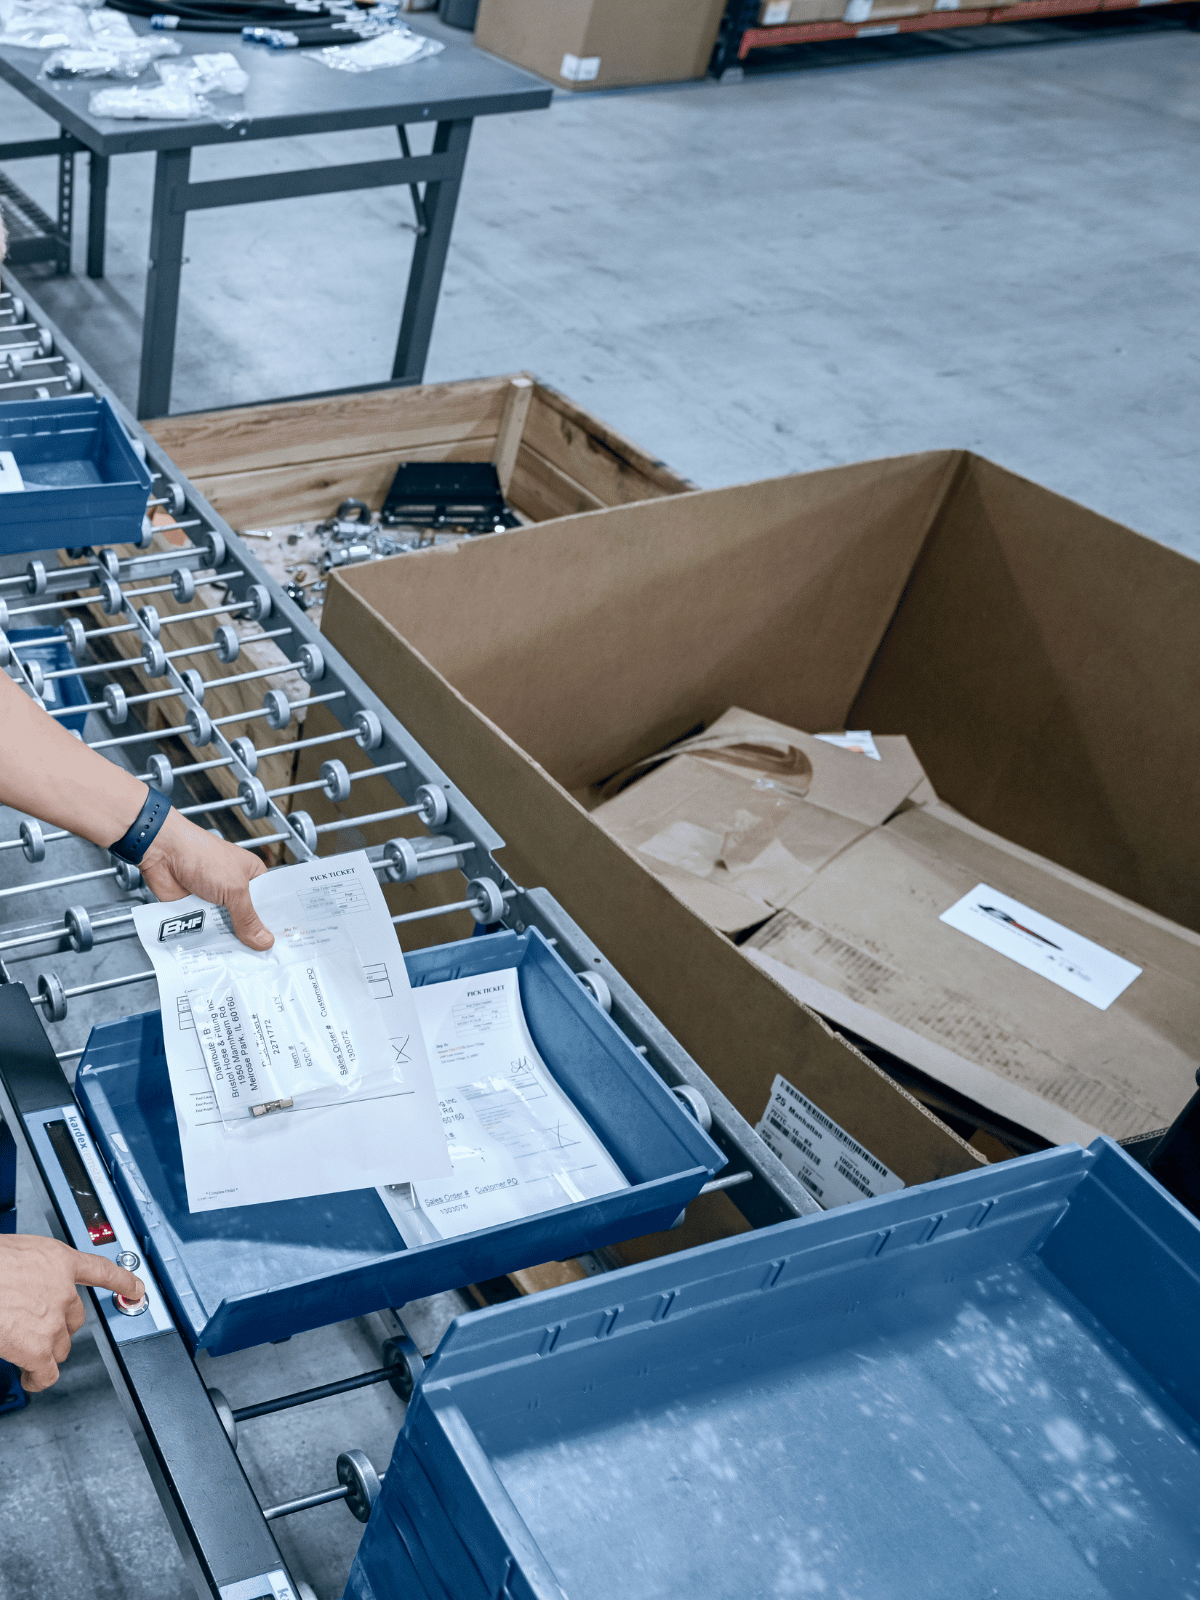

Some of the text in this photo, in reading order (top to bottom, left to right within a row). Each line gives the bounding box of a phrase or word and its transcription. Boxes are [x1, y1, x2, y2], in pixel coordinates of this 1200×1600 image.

[309, 867, 356, 882] PICK TICKET
[160, 914, 203, 939] BHF
[306, 968, 315, 980] PO
[312, 982, 328, 1018] Customer
[483, 985, 505, 994] TICKET
[226, 996, 240, 1022] 60160
[234, 1023, 242, 1032] IL
[264, 1019, 280, 1055] 2271772
[219, 1006, 246, 1085] 1950 Mannheim Rd
[329, 1032, 341, 1053] Order
[341, 1030, 356, 1062] 1303072
[220, 1048, 232, 1069] Hose
[290, 1052, 302, 1069] Item
[337, 1054, 349, 1076] Sales
[226, 1071, 240, 1098] Bristol
[245, 1057, 258, 1091] Melrose
[442, 1113, 465, 1124] 60160
[774, 1093, 787, 1108] 25
[788, 1105, 823, 1140] Manhattan
[68, 1115, 104, 1185] kardex remstar
[425, 1197, 444, 1207] Sales
[444, 1191, 464, 1202] Order
[475, 1182, 506, 1194] Customer
[507, 1177, 519, 1186] PO
[440, 1203, 469, 1215] 1303076
